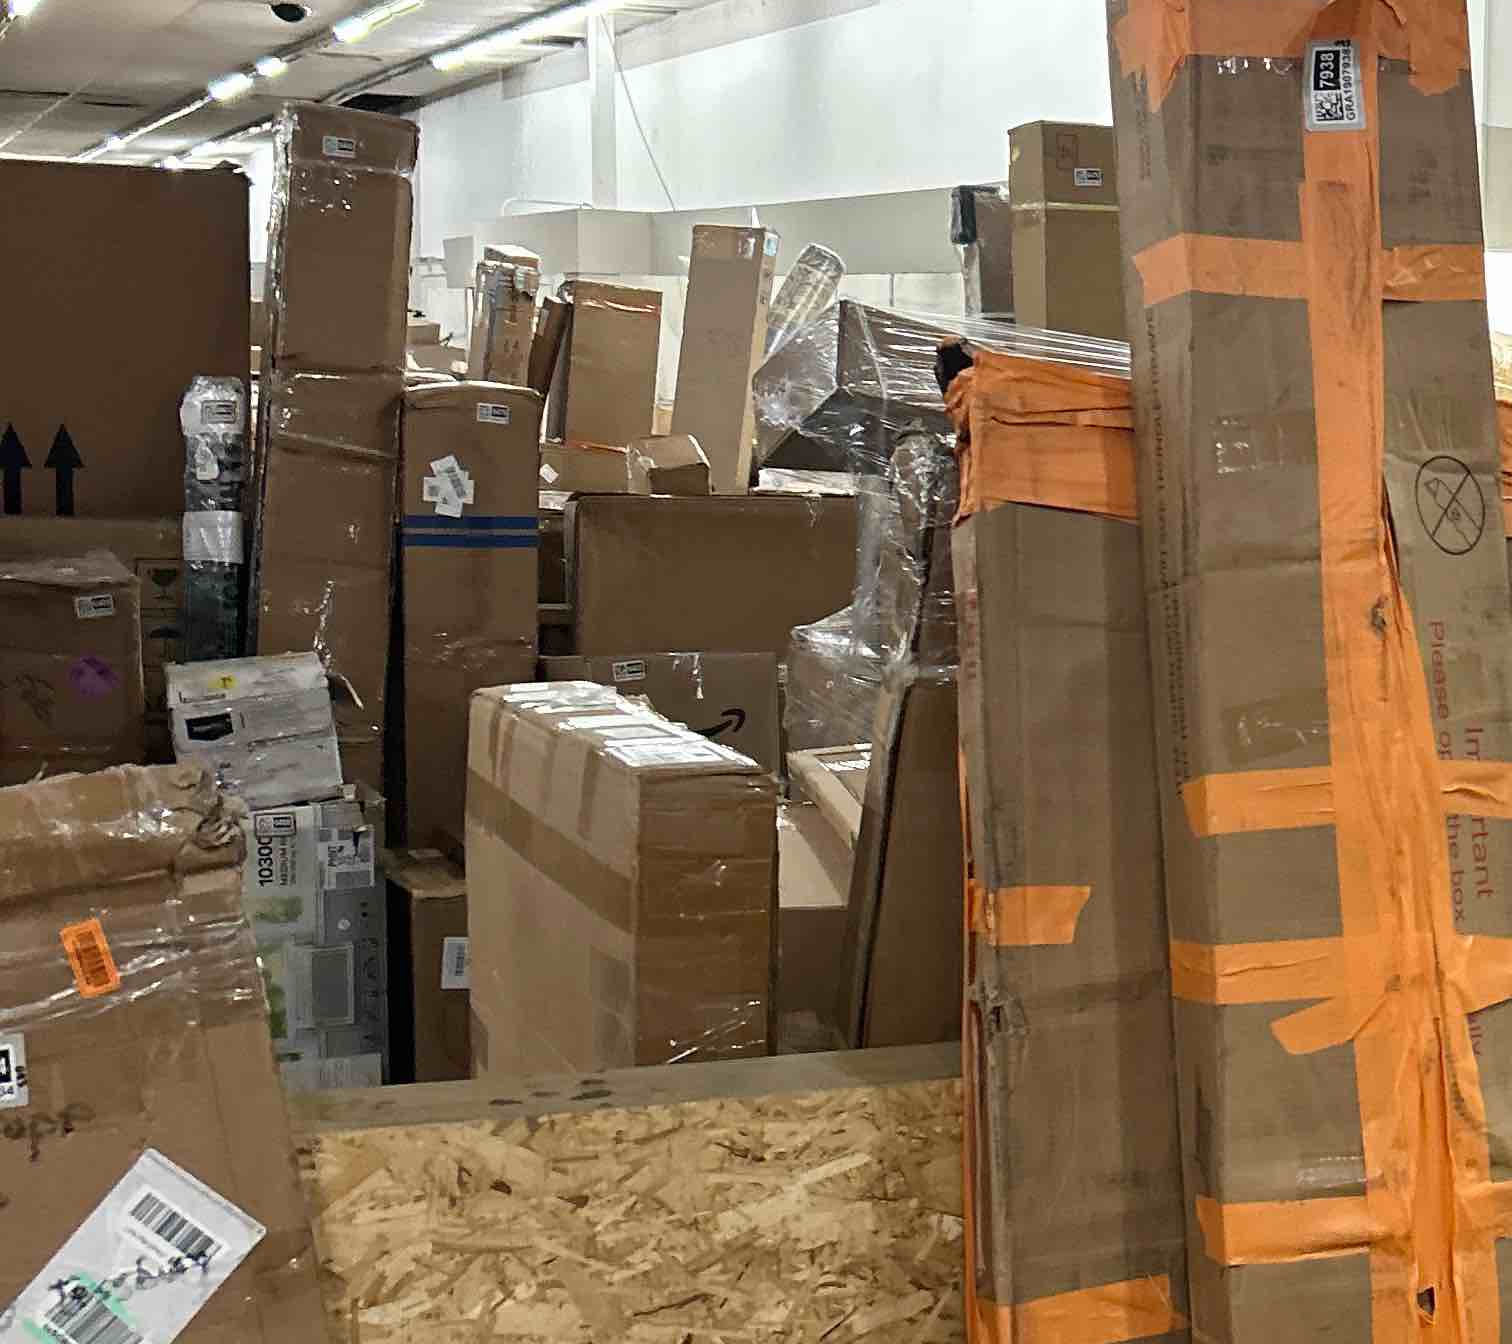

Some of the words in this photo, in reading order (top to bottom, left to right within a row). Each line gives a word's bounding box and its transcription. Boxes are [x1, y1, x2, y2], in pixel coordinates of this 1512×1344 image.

[1319, 52, 1337, 89] 7938
[1464, 727, 1494, 899] Imrtant
[1450, 868, 1465, 921] box
